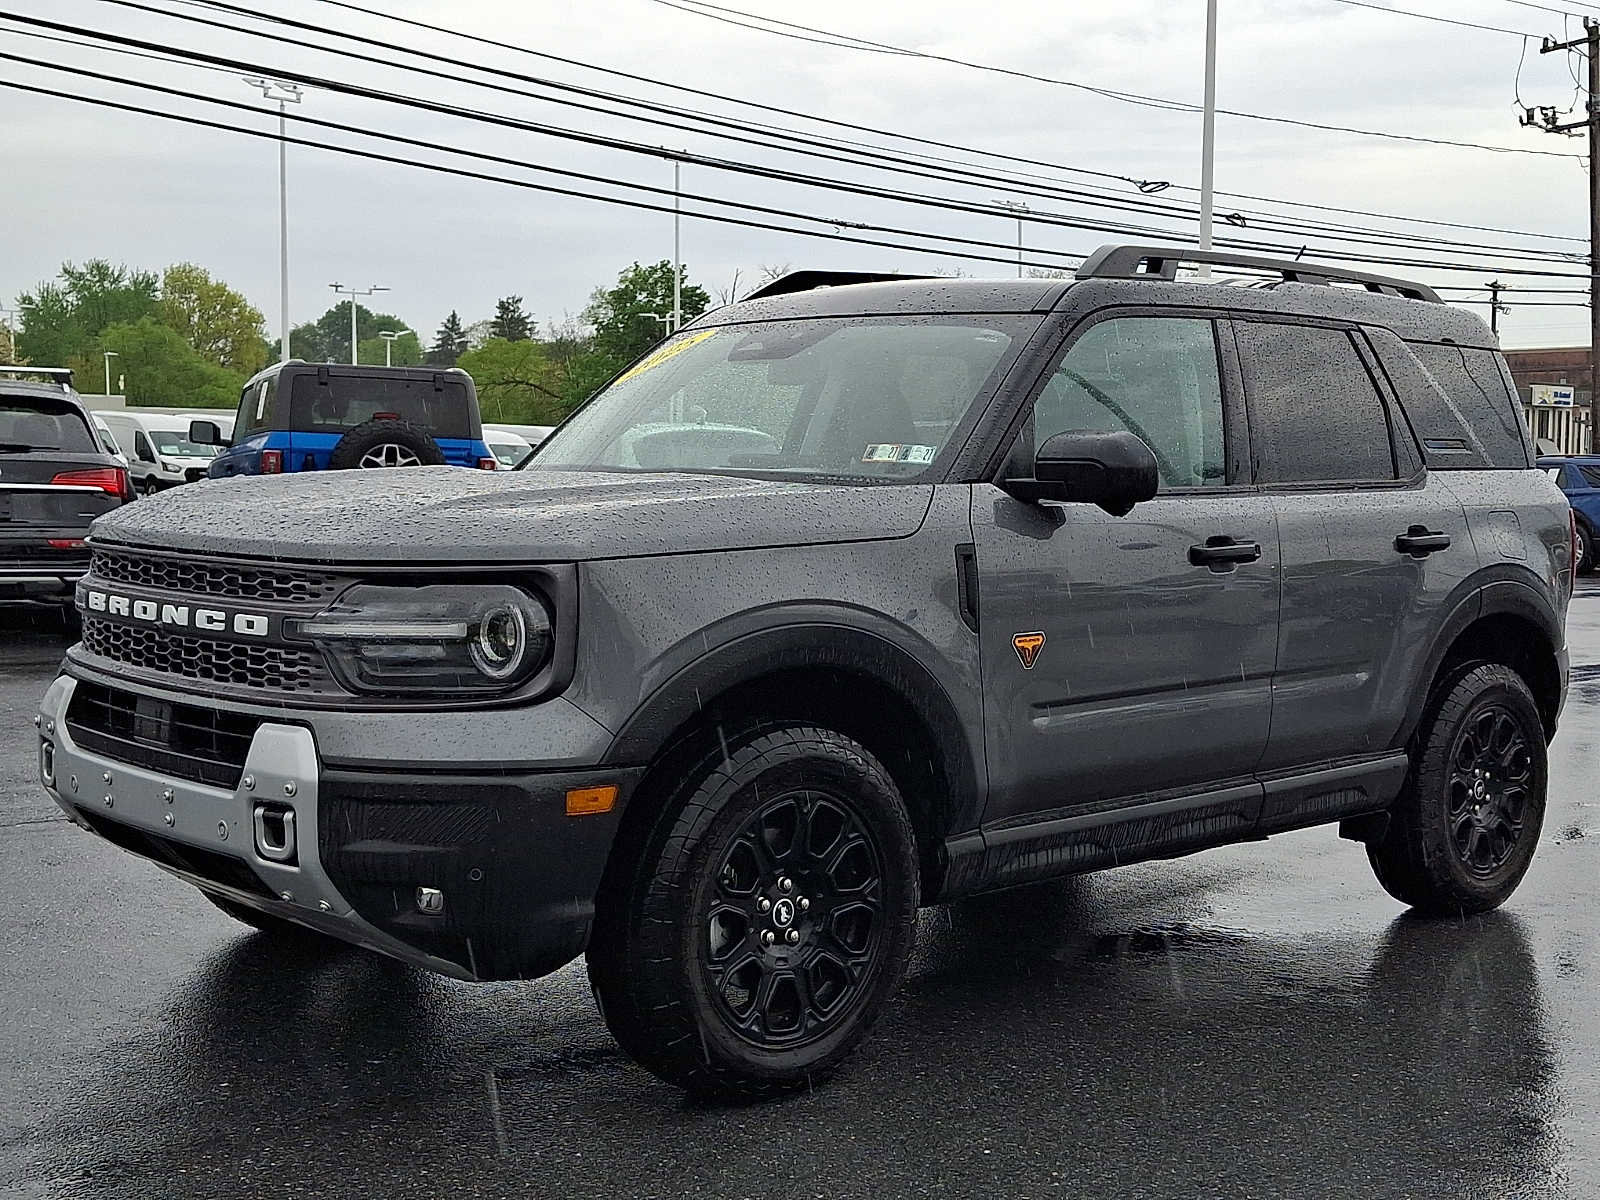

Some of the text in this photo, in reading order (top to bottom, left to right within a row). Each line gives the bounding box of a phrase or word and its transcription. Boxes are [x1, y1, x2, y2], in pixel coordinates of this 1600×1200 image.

[888, 447, 898, 459] 27
[922, 448, 933, 461] 27
[88, 591, 269, 636] BRONCO
